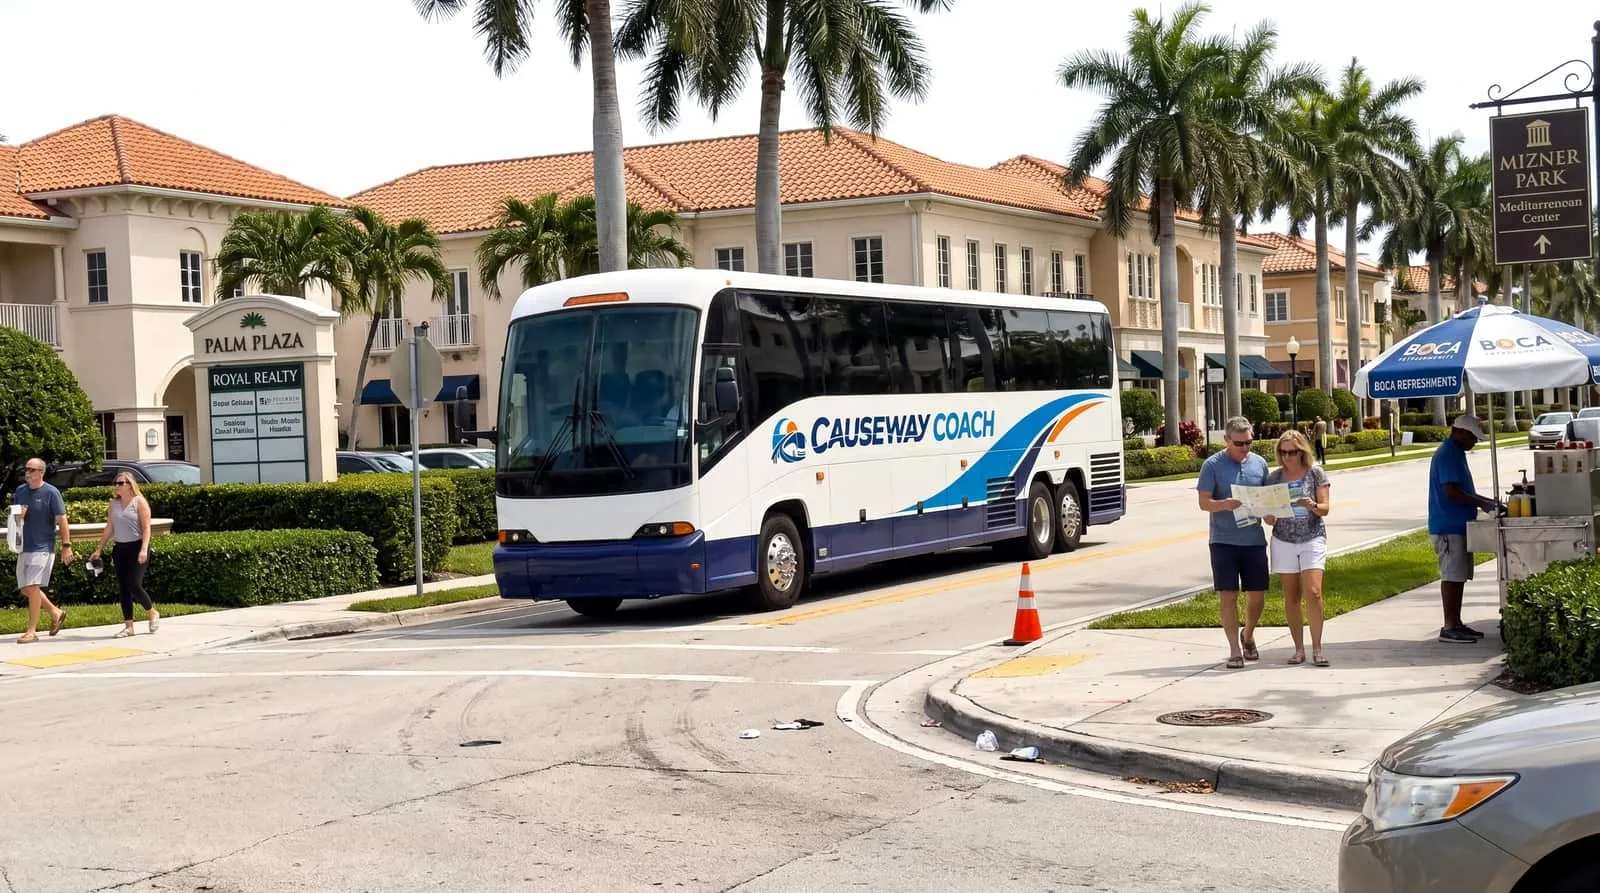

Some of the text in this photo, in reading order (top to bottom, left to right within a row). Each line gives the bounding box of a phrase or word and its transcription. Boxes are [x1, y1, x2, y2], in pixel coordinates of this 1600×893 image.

[1500, 149, 1582, 171] MIZNER
[1516, 169, 1567, 189] PARK
[1522, 213, 1561, 224] Center
[205, 332, 304, 354] PALM PLAZA
[1403, 341, 1462, 356] BOCA
[1480, 335, 1552, 351] BOCA
[213, 369, 298, 386] ROYAL REALTY
[1374, 376, 1457, 392] BOCA REFRESHMENTS
[933, 410, 995, 442] COACH
